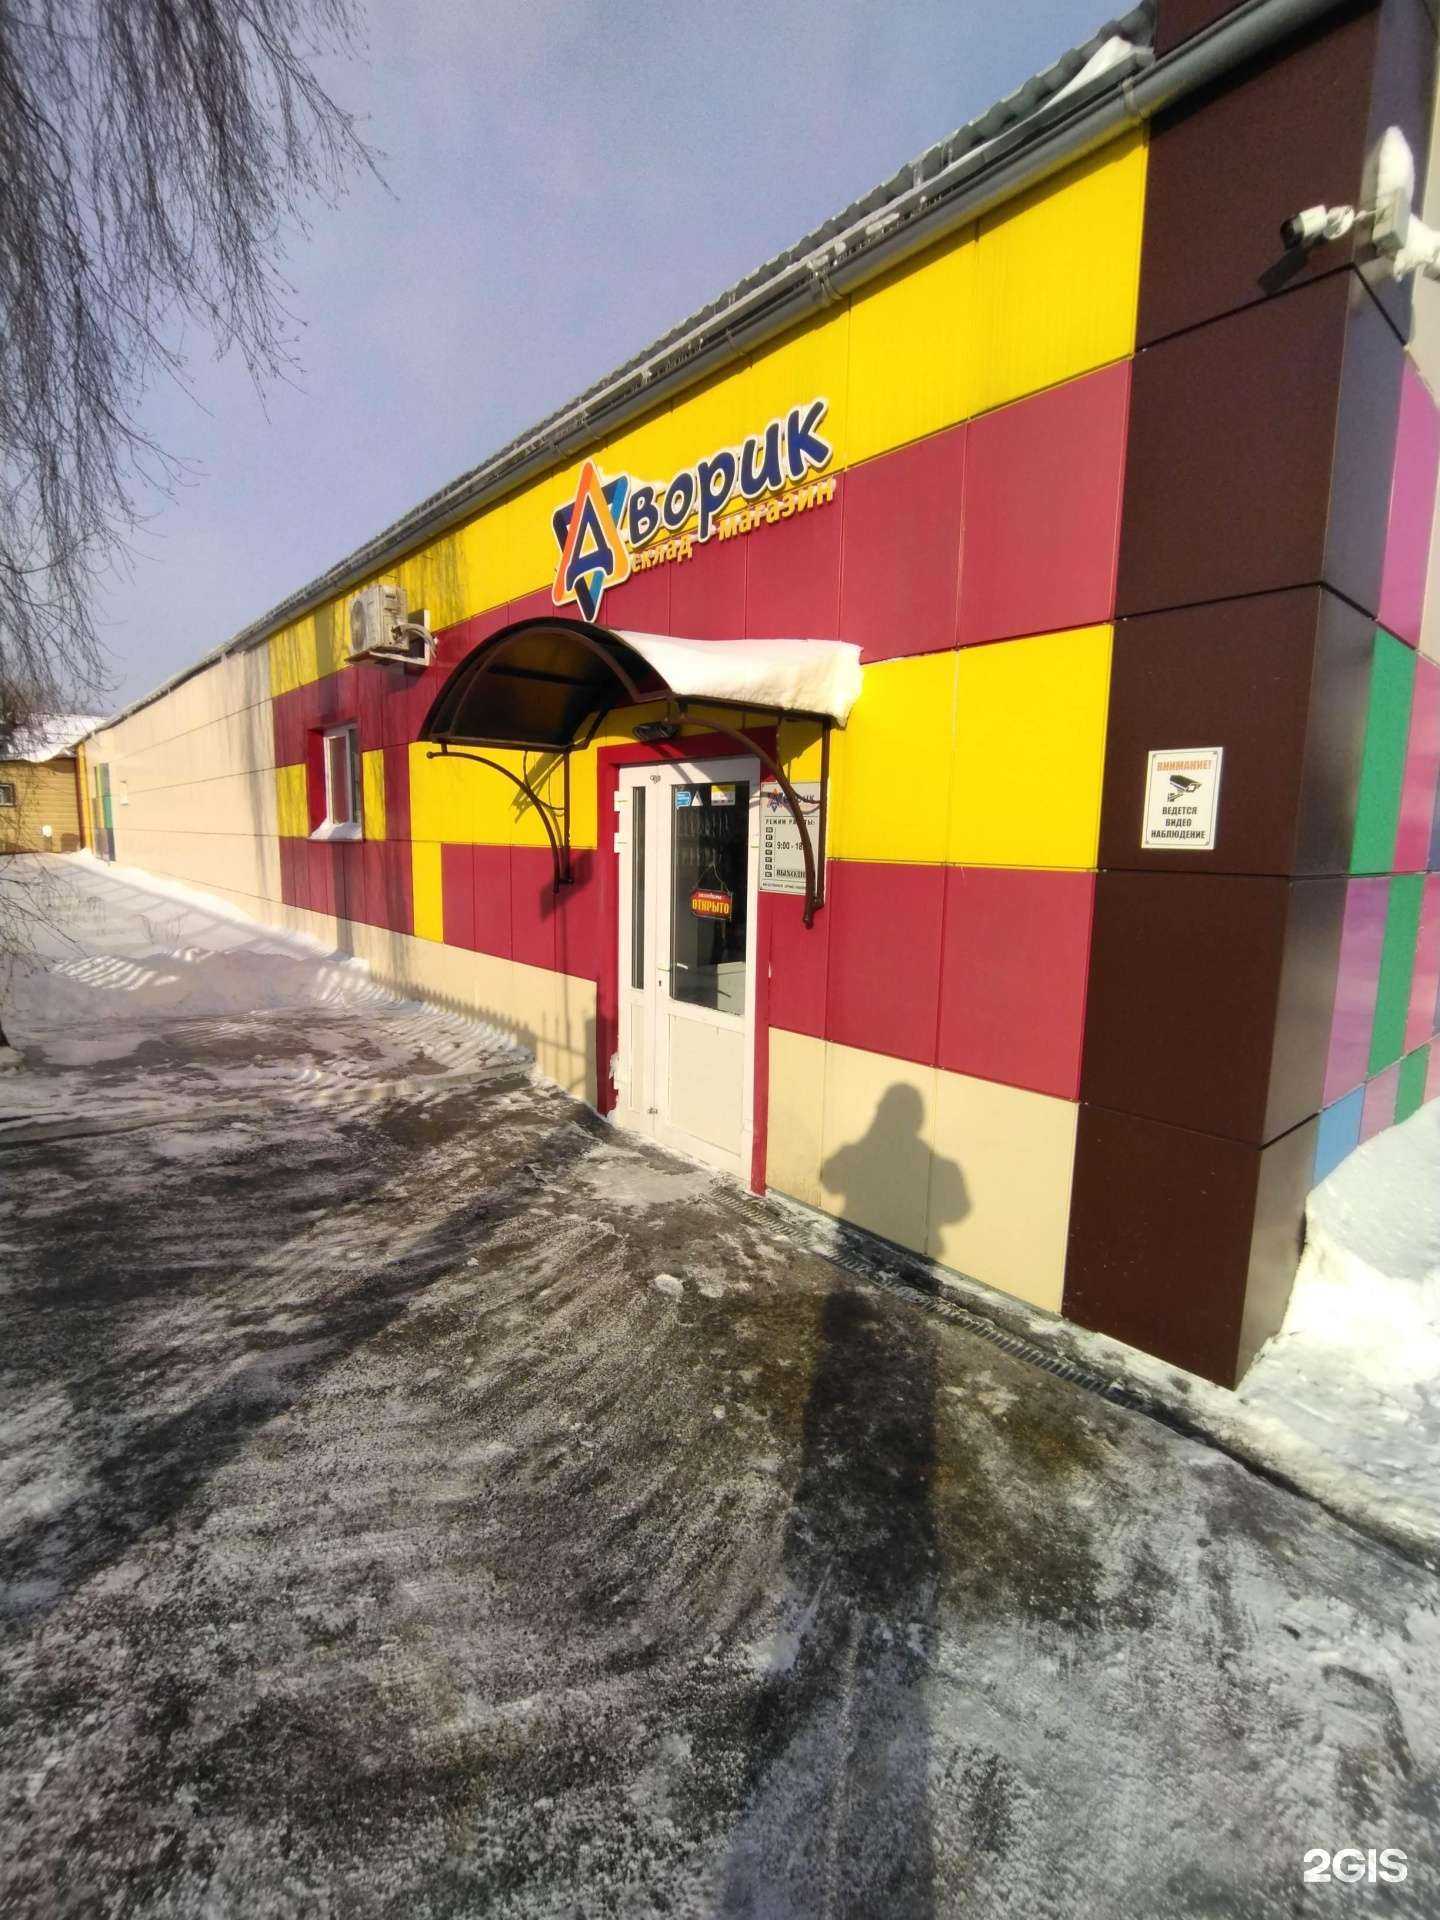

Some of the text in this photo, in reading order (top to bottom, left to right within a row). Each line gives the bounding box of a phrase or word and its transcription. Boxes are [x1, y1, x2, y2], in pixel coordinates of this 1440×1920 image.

[554, 399, 833, 608] Дворик
[1162, 806, 1198, 815] ВЕДЕТСЯ
[1165, 818, 1193, 828] ВИДЕО
[1151, 830, 1206, 839] НАБЛЮДЕНИЕ
